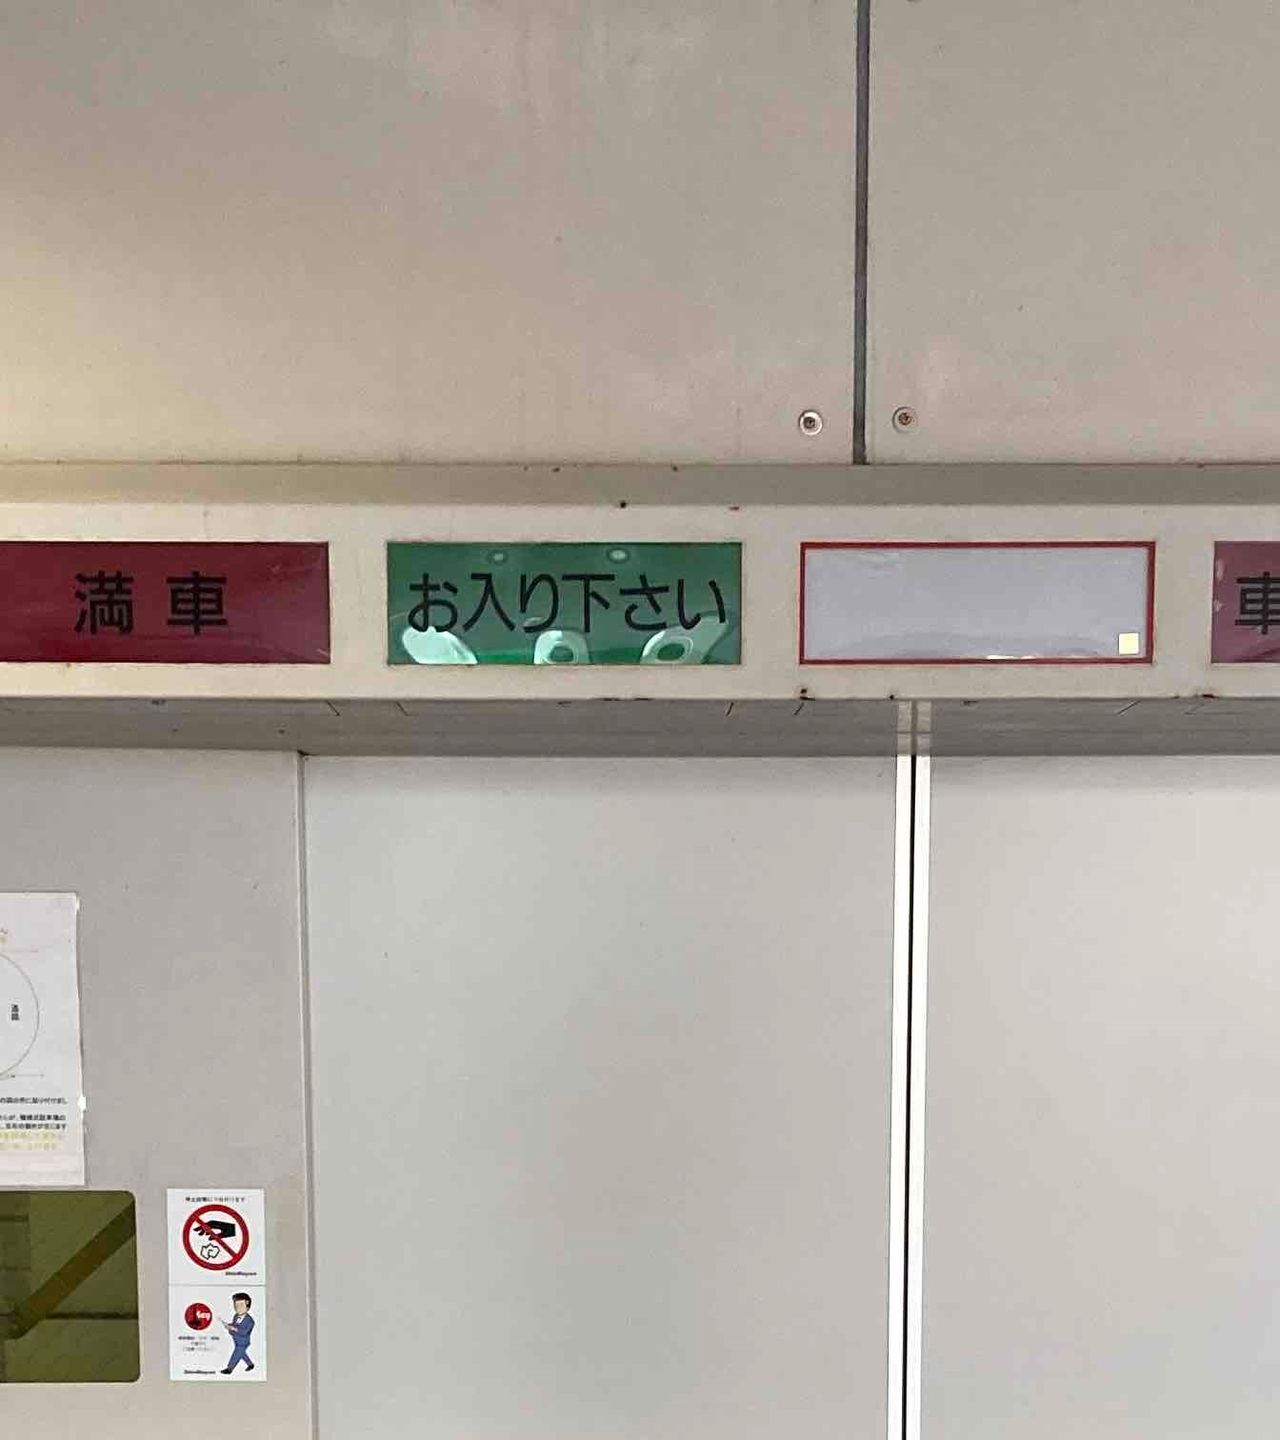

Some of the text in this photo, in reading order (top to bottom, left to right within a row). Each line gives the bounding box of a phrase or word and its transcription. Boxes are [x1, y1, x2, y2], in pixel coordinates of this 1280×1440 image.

[73, 570, 228, 635] 満車
[405, 571, 728, 634] お入り下さい
